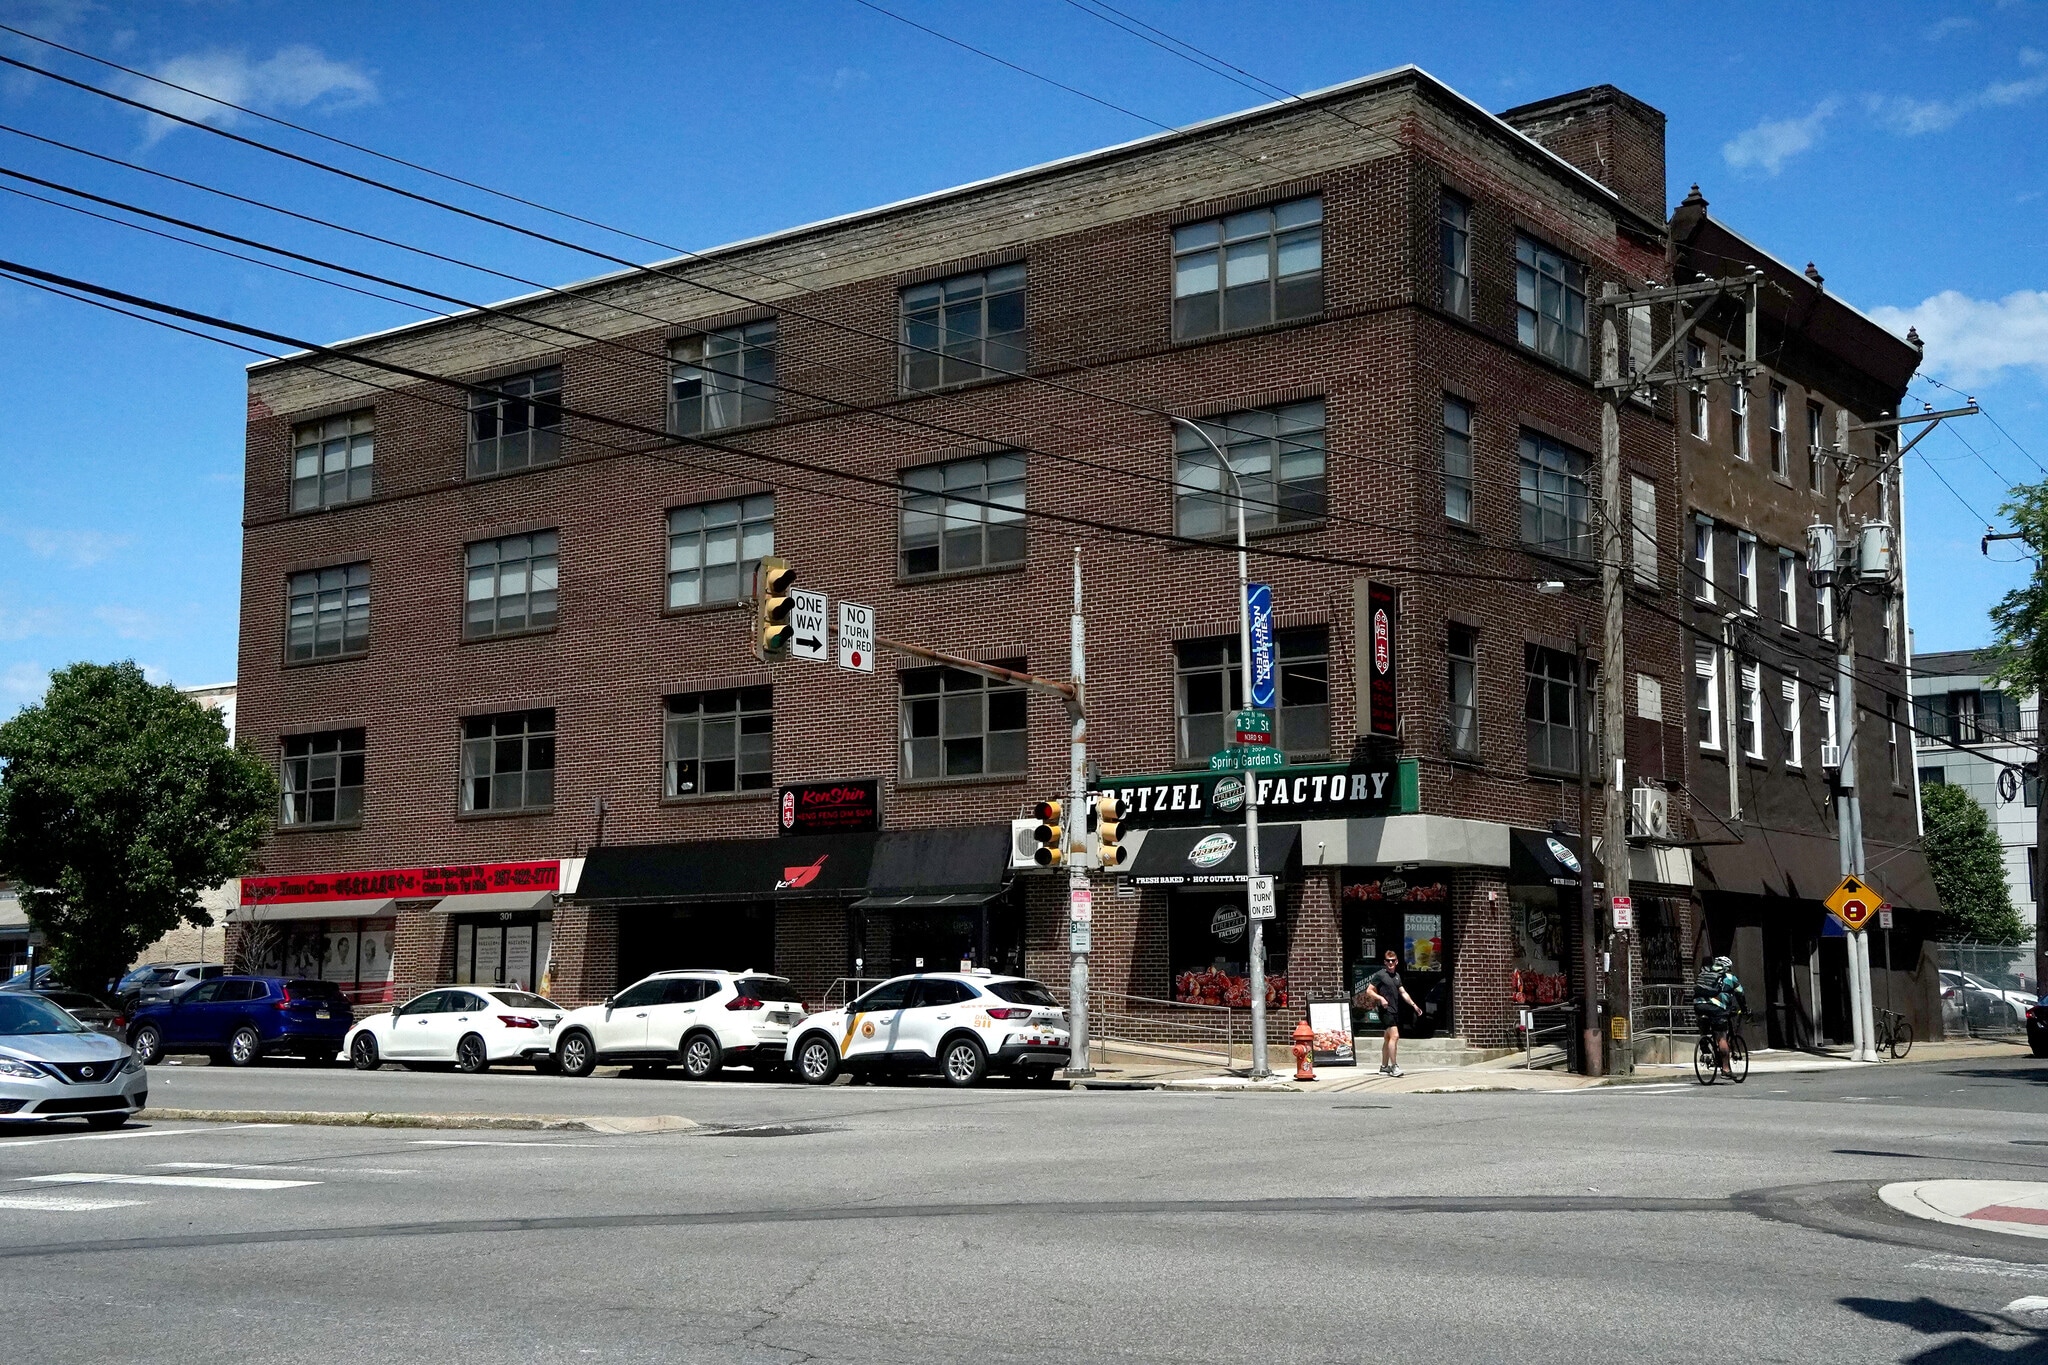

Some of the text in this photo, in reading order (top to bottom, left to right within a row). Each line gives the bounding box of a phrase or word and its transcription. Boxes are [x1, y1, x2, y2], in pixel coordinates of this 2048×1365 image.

[796, 596, 822, 613] ONE
[847, 608, 866, 624] NO
[796, 614, 823, 632] WAY
[844, 625, 869, 639] TURN
[841, 637, 872, 652] ON RED
[1253, 605, 1263, 685] NORTHERN
[1260, 614, 1271, 679] LIBERTIES
[1245, 717, 1269, 731] 3rd St
[1211, 753, 1282, 770] Spring Garden St
[1219, 782, 1237, 793] PHILLY
[1256, 772, 1390, 806] FACTORY
[1219, 796, 1243, 808] FACTORY
[1160, 876, 1184, 884] BAKED
[1209, 875, 1234, 883] OUTTA
[1256, 881, 1266, 889] NO
[1253, 893, 1271, 902] TURN
[1217, 911, 1237, 921] PHILLY
[1252, 905, 1273, 915] ON RED
[500, 912, 513, 921] 301
[1405, 915, 1439, 924] FROZEN
[1071, 923, 1077, 932] 3
[1215, 917, 1243, 931] PRETZEL
[1218, 927, 1243, 939] FACTORY
[973, 1019, 992, 1029] 911
